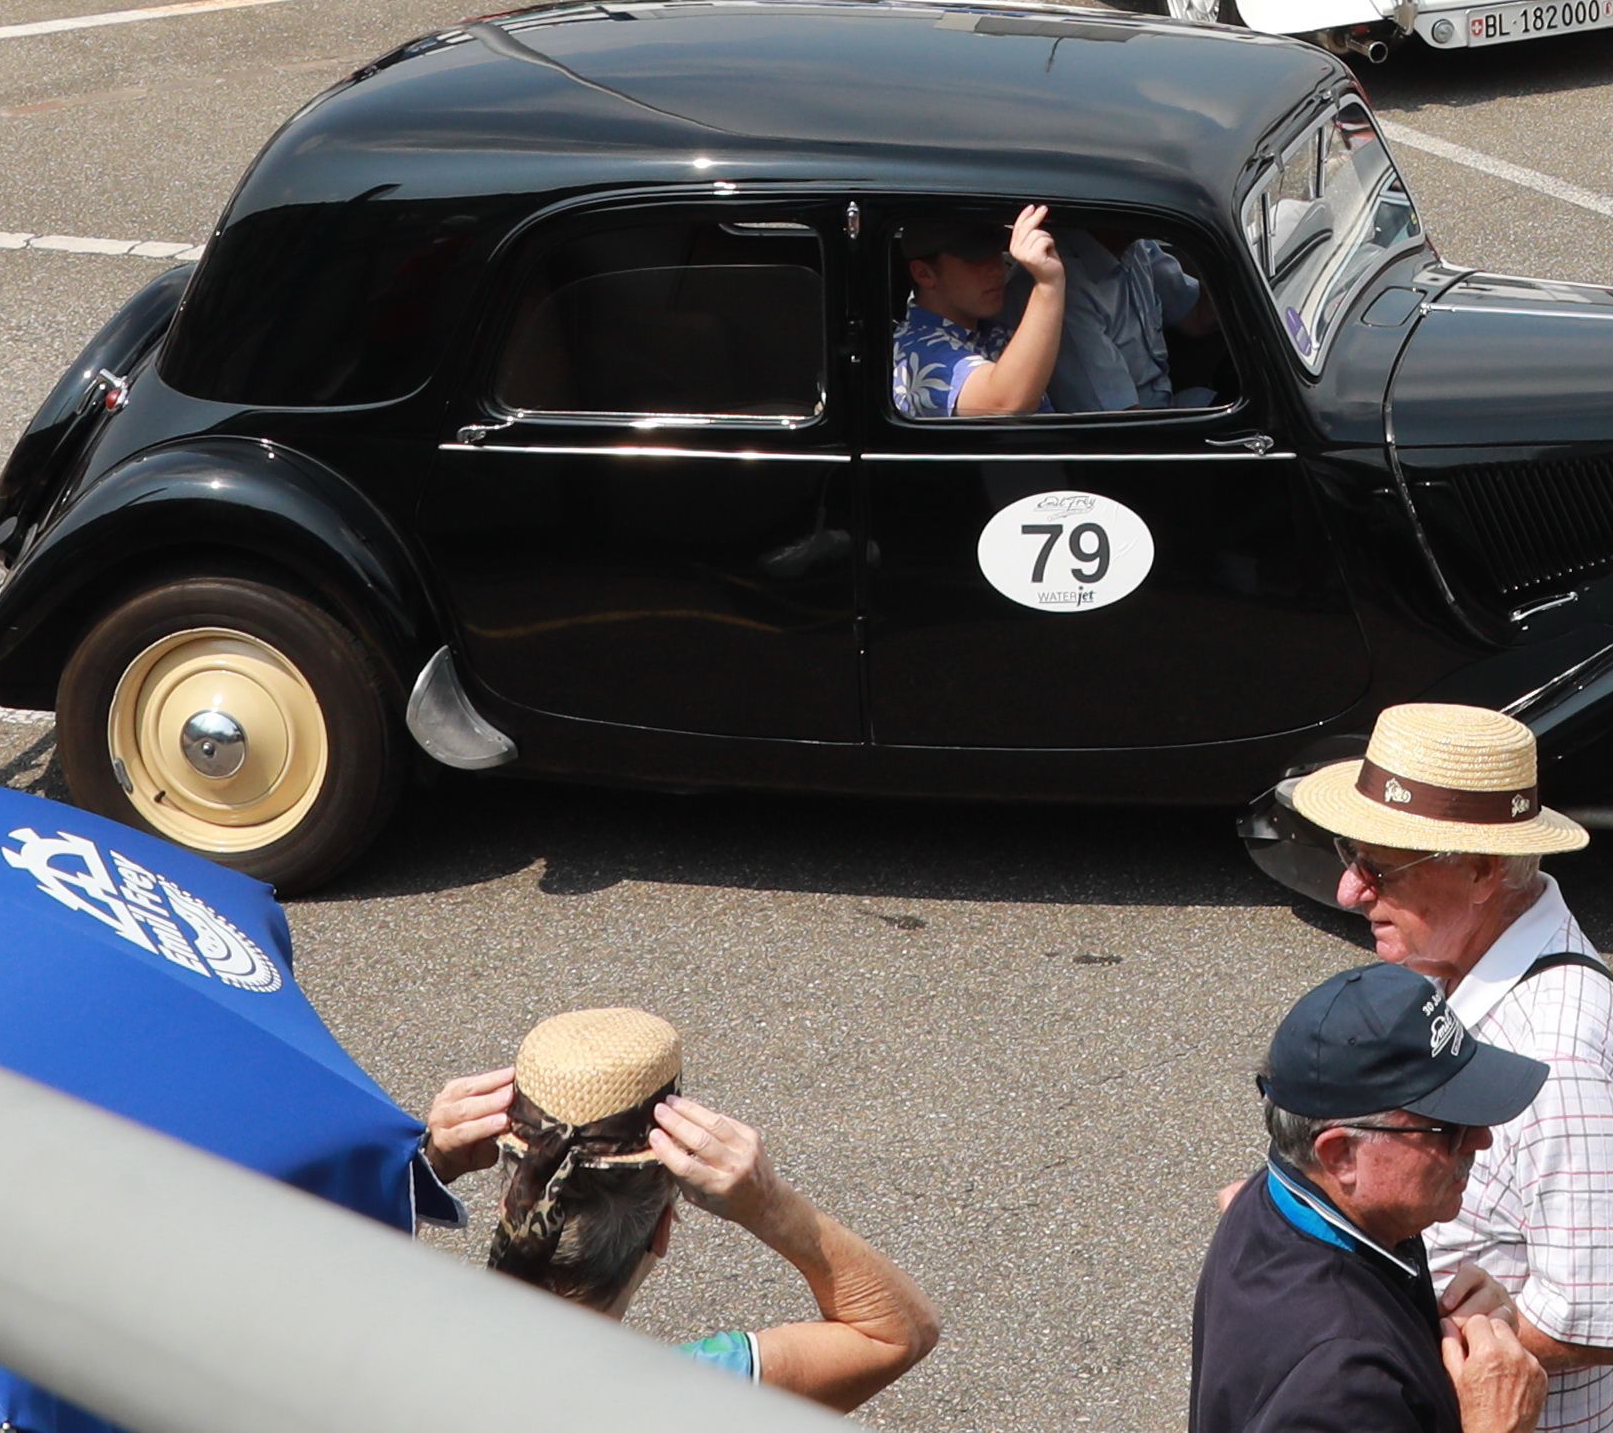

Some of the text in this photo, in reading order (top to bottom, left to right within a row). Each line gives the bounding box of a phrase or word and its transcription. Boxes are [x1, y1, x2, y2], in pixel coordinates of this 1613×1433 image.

[1021, 522, 1111, 584] 79
[1037, 586, 1097, 607] WATERjet
[118, 854, 212, 978] Emil Frey
